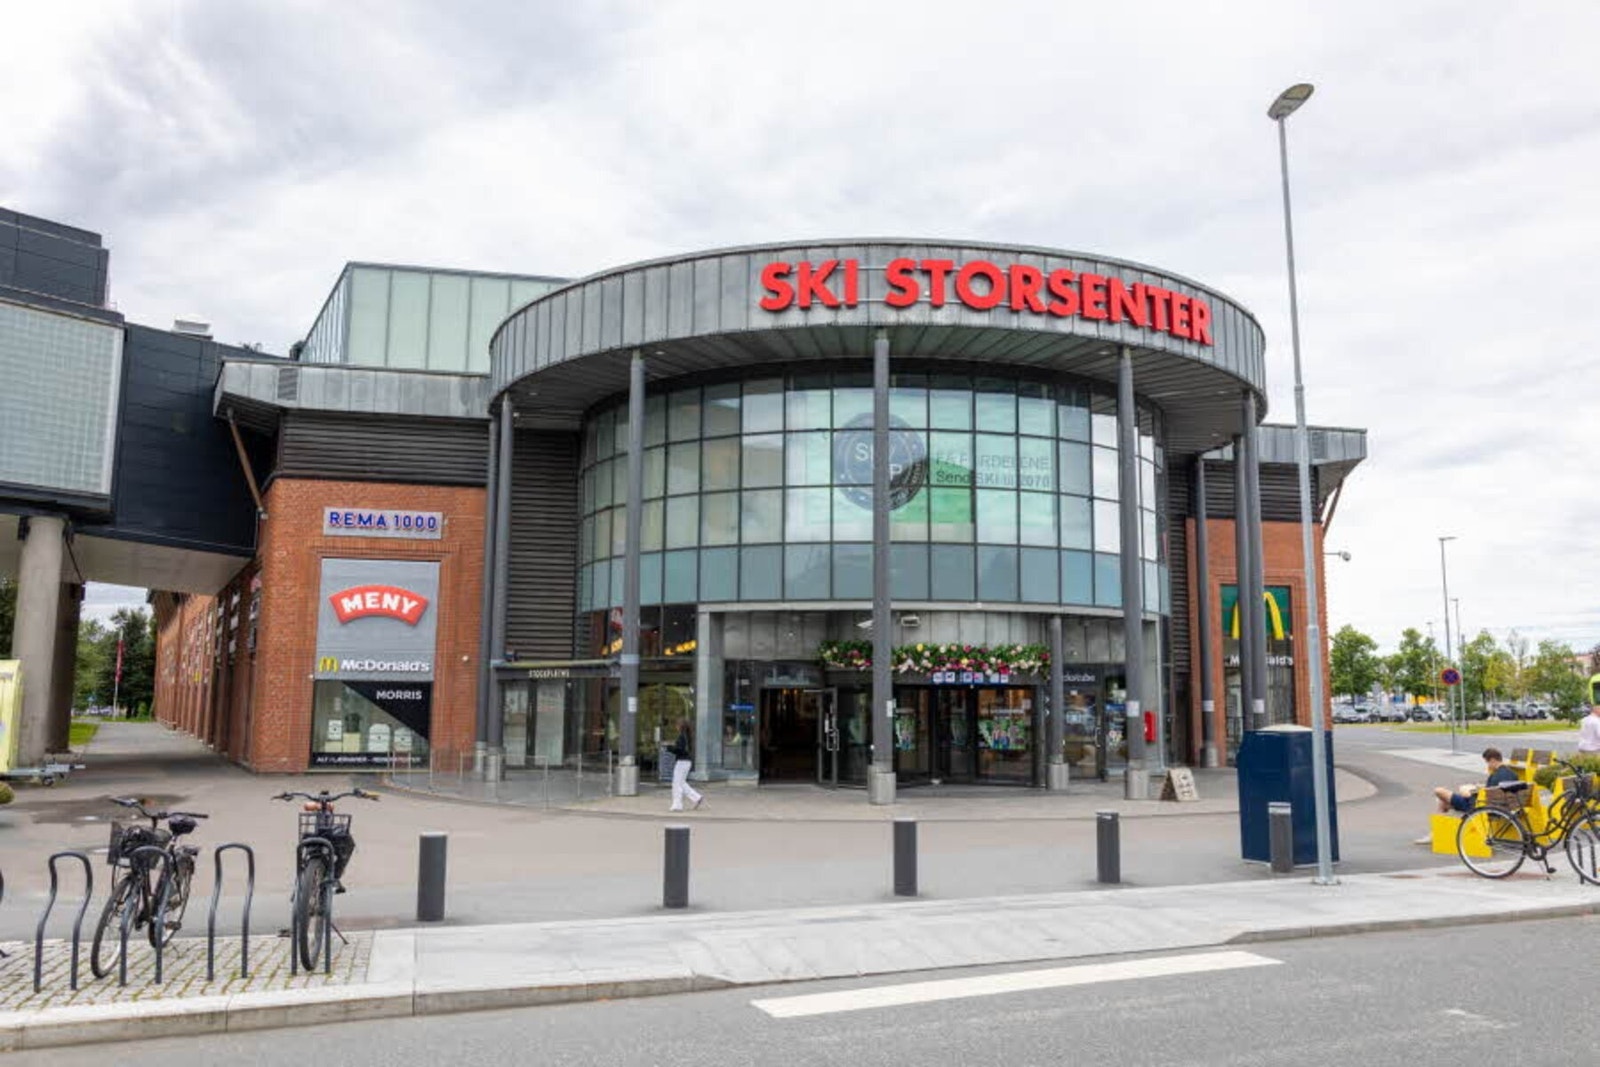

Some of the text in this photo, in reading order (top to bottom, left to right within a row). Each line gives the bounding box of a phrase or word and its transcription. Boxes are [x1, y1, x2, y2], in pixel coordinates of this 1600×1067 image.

[759, 257, 1213, 346] SKI STORSENTER
[329, 511, 438, 529] REMA 1000
[340, 592, 418, 615] MENY
[341, 659, 430, 672] McDonald's
[376, 689, 423, 700] MORRIS
